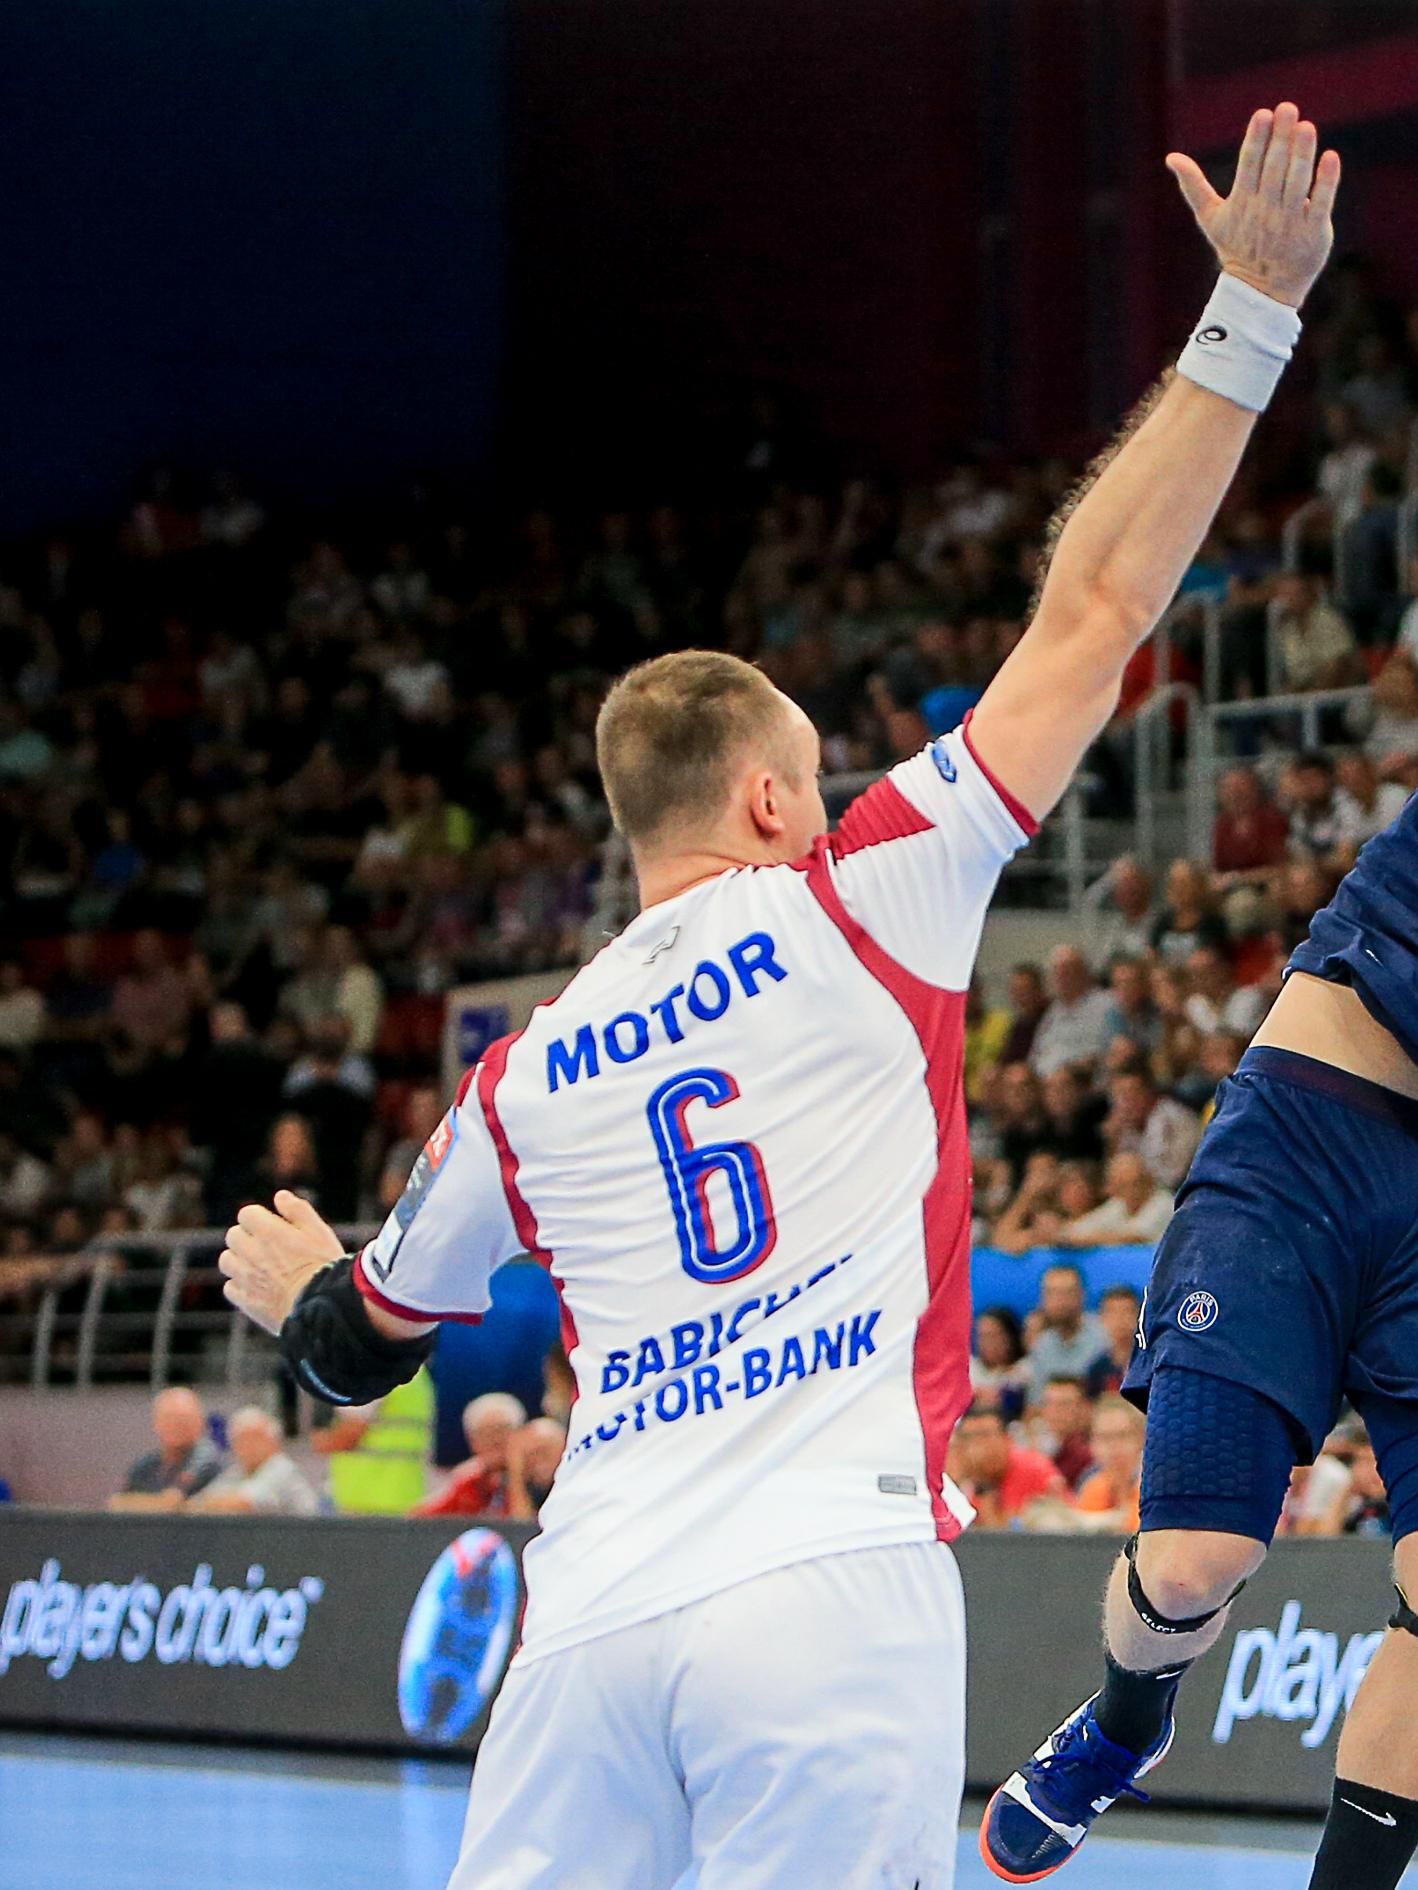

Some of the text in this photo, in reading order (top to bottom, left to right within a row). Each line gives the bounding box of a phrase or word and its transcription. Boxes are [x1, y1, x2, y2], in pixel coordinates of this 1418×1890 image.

[546, 930, 789, 1093] MOTOR
[646, 1066, 781, 1284] 6
[1190, 1293, 1214, 1307] PARIS
[568, 1309, 883, 1461] OTOR-BANK
[1141, 1612, 1177, 1633] SELECT
